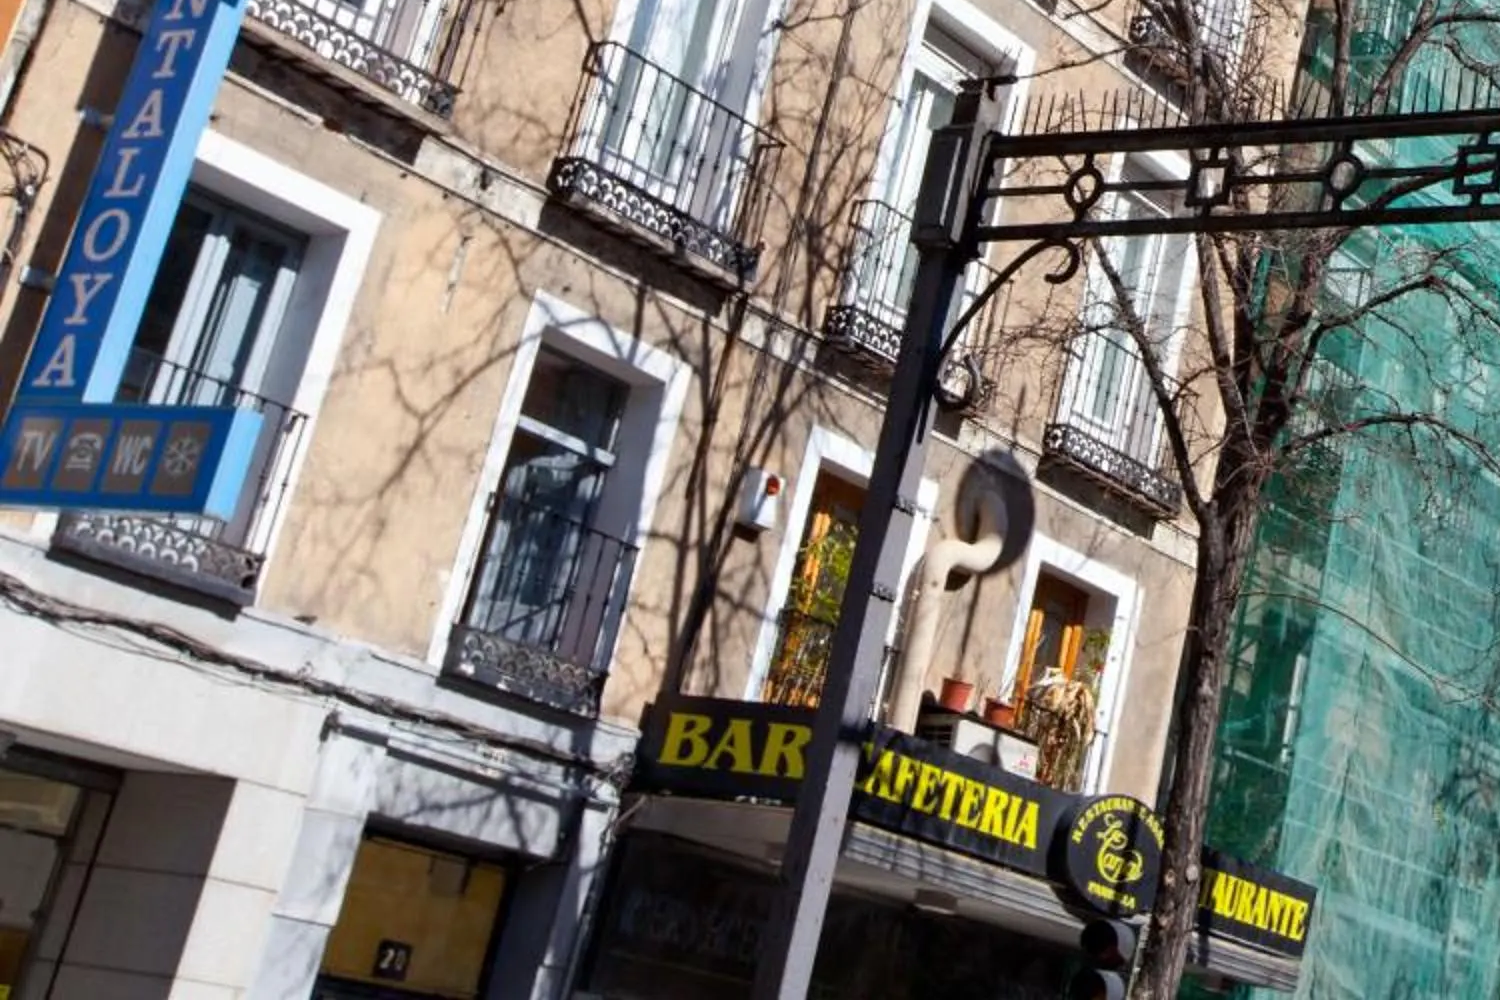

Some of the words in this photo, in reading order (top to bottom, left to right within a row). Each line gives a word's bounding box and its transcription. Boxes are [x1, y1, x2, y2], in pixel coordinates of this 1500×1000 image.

[17, 431, 56, 472] TV
[112, 434, 153, 476] WC
[656, 712, 812, 779] BAR
[1199, 867, 1309, 941] TAURANTE
